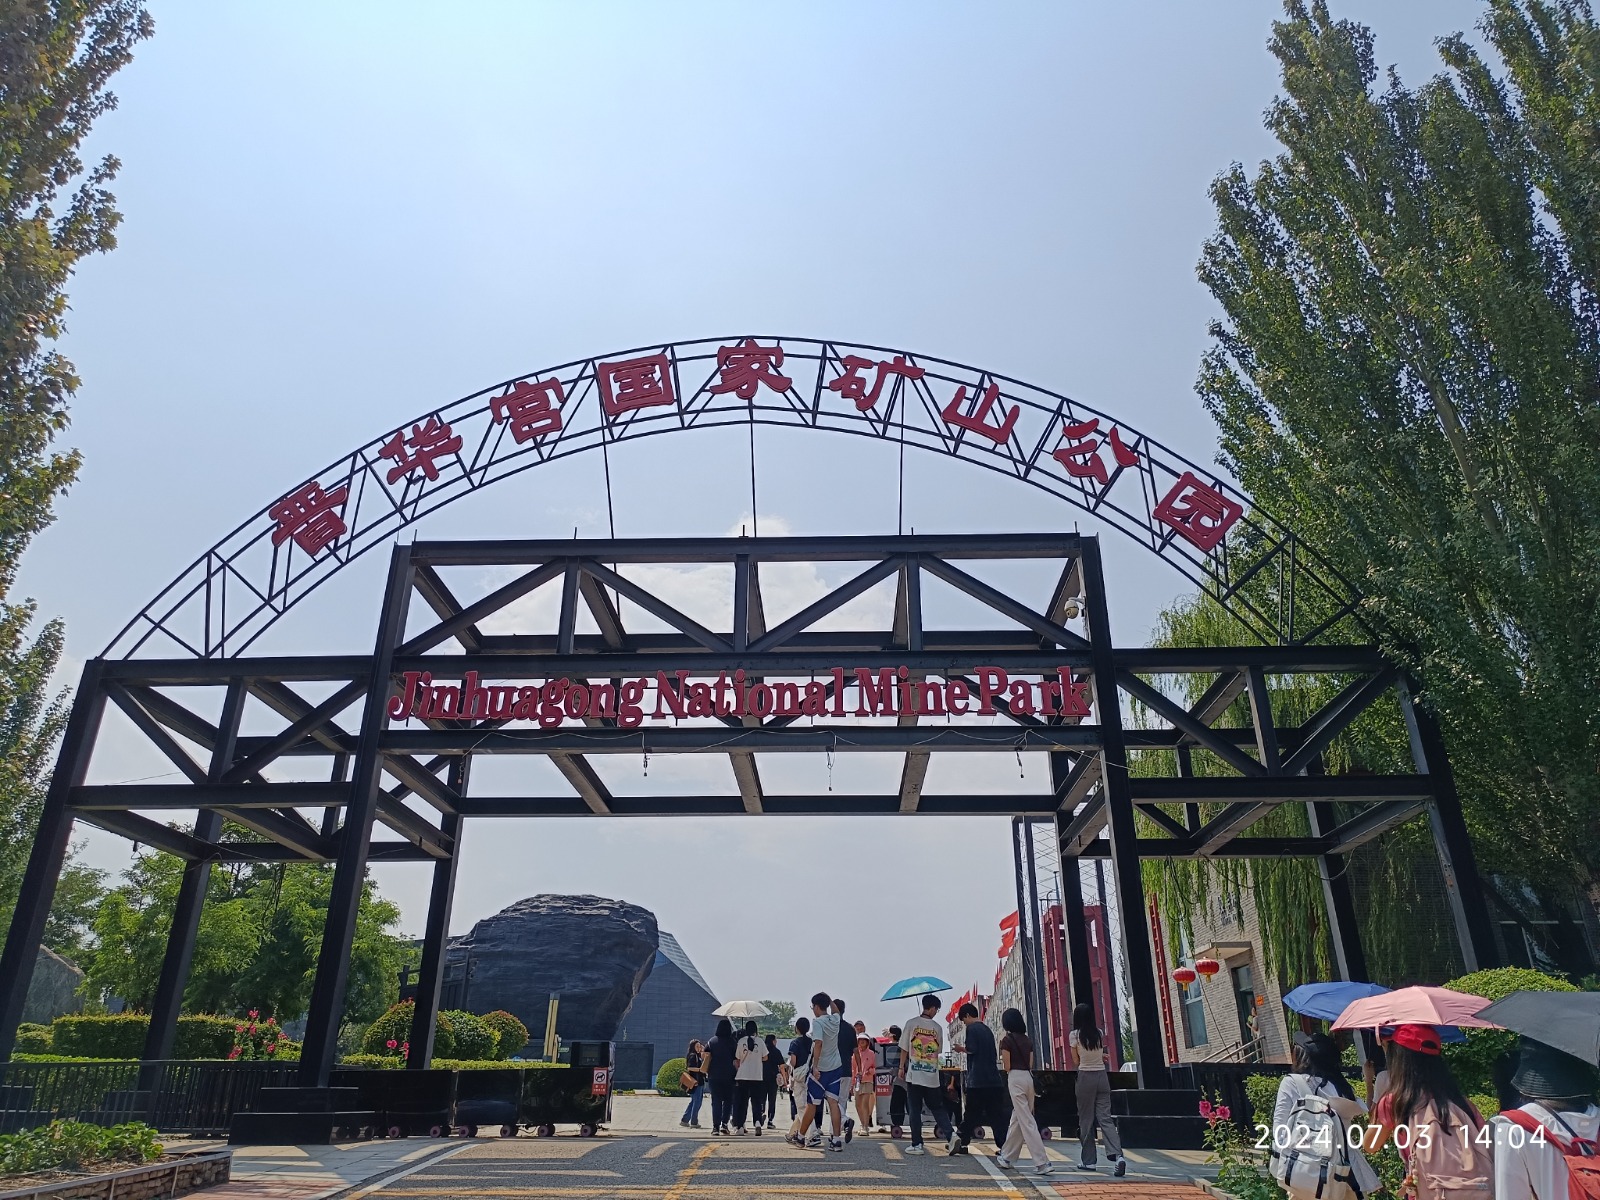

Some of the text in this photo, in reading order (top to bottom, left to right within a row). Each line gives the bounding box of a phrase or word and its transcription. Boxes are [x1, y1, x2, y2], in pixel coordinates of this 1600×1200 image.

[268, 338, 1244, 555] 晋华宫国家矿山公园
[387, 665, 1092, 728] Jinhuagong National Mine Park
